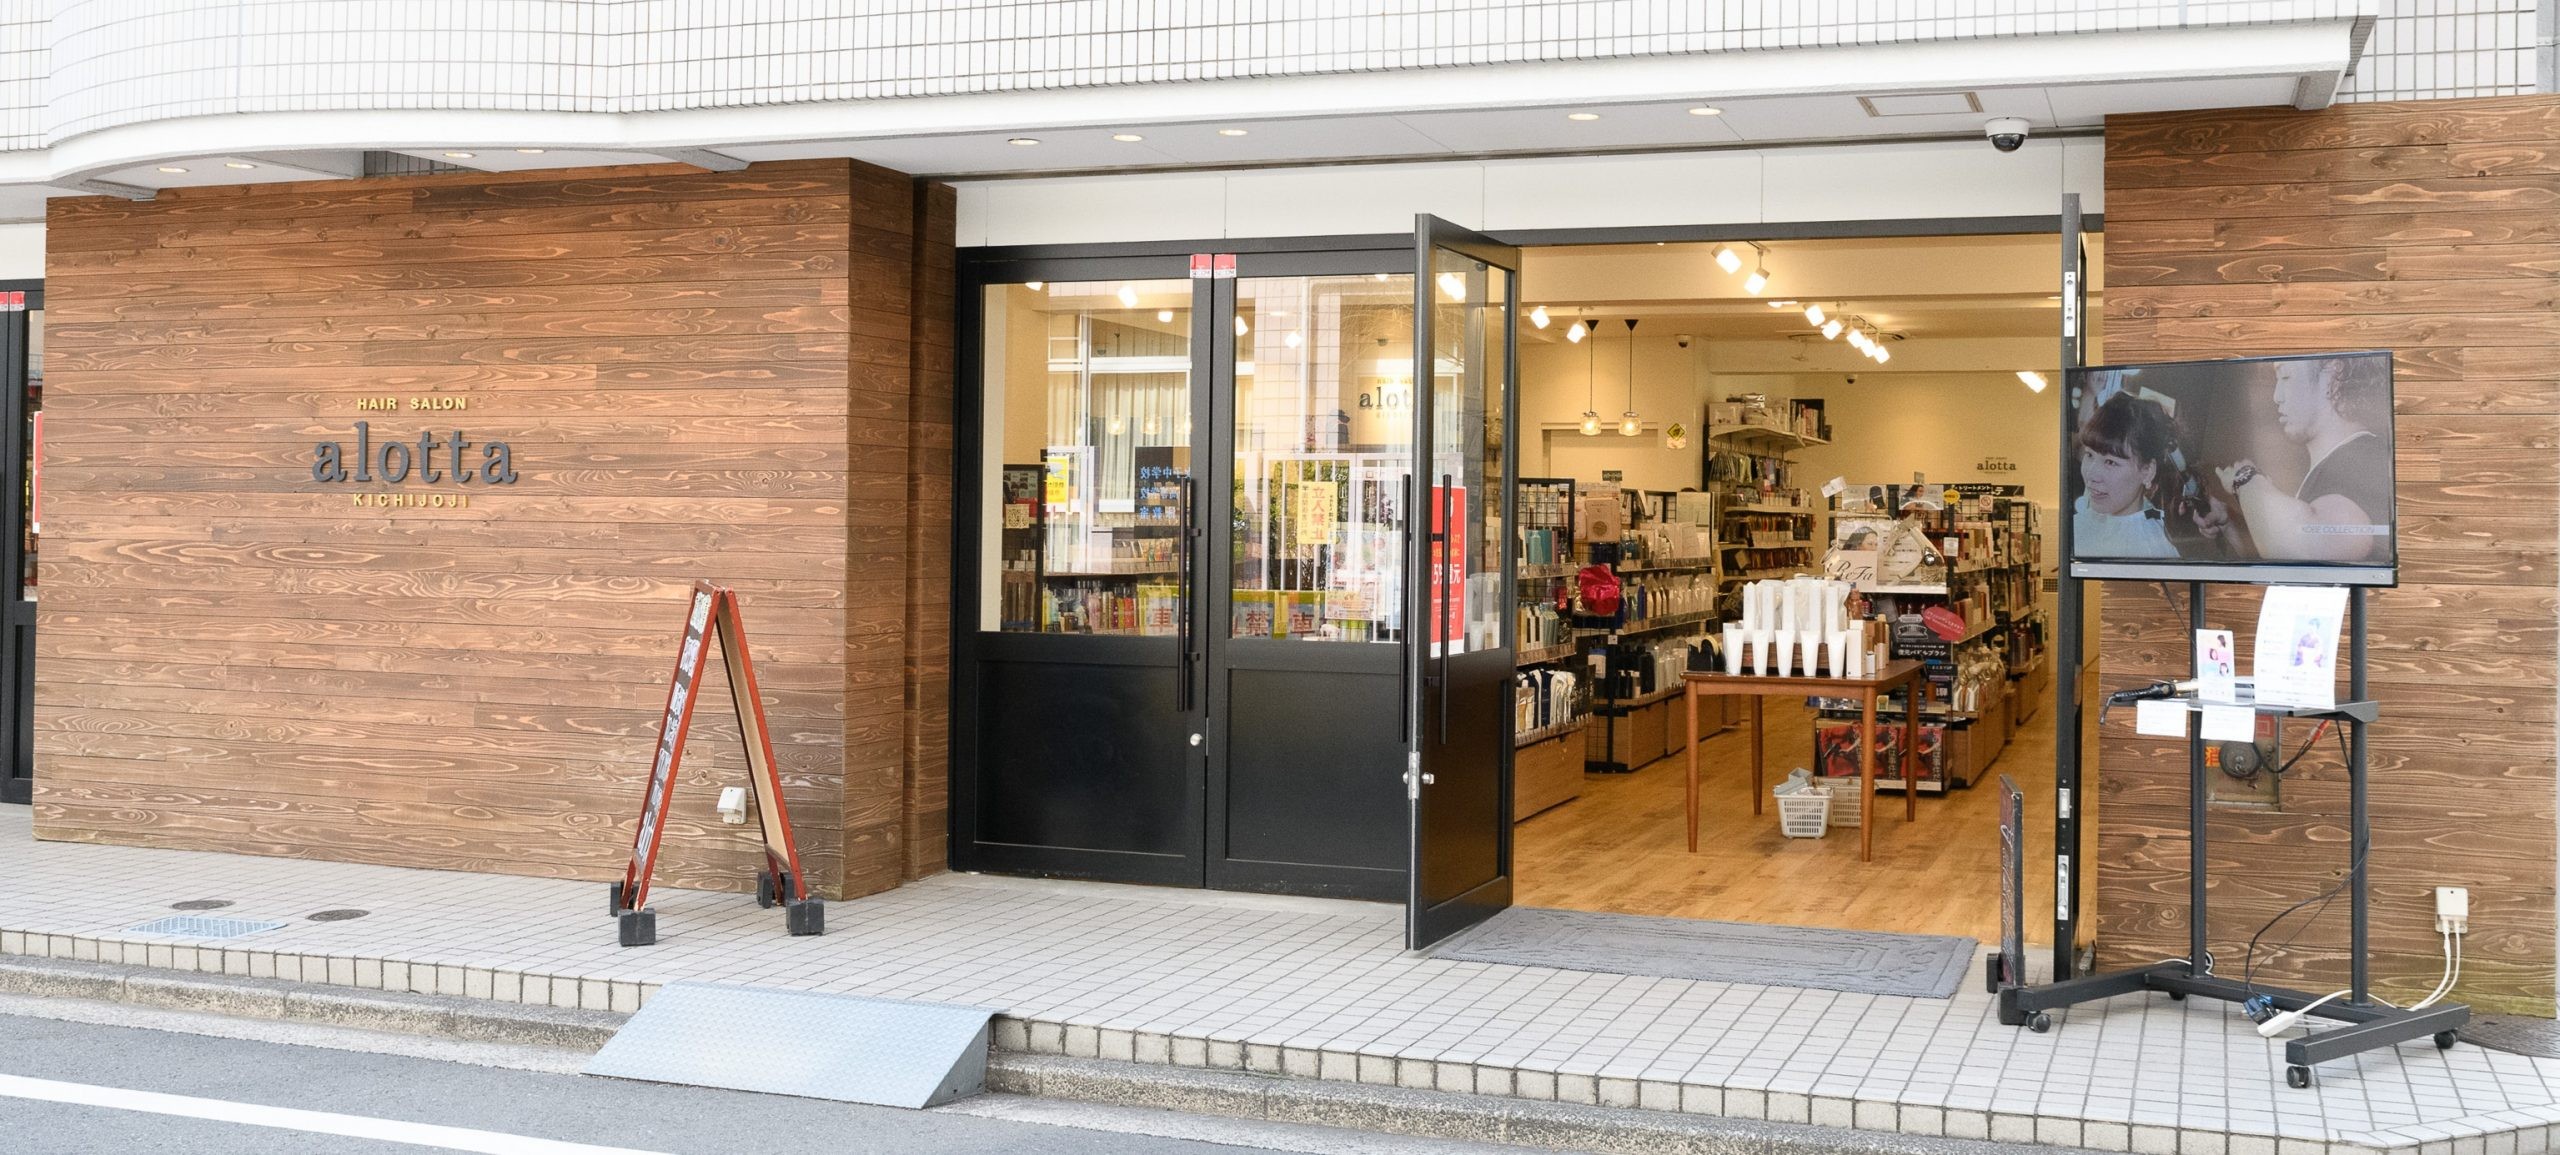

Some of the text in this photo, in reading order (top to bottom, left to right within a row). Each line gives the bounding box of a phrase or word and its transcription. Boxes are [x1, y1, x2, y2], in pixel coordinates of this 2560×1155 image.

[357, 397, 467, 411] HAIR SALON
[312, 421, 518, 484] alotta
[1976, 460, 2016, 471] alotta
[353, 493, 470, 508] KICHIJOJI
